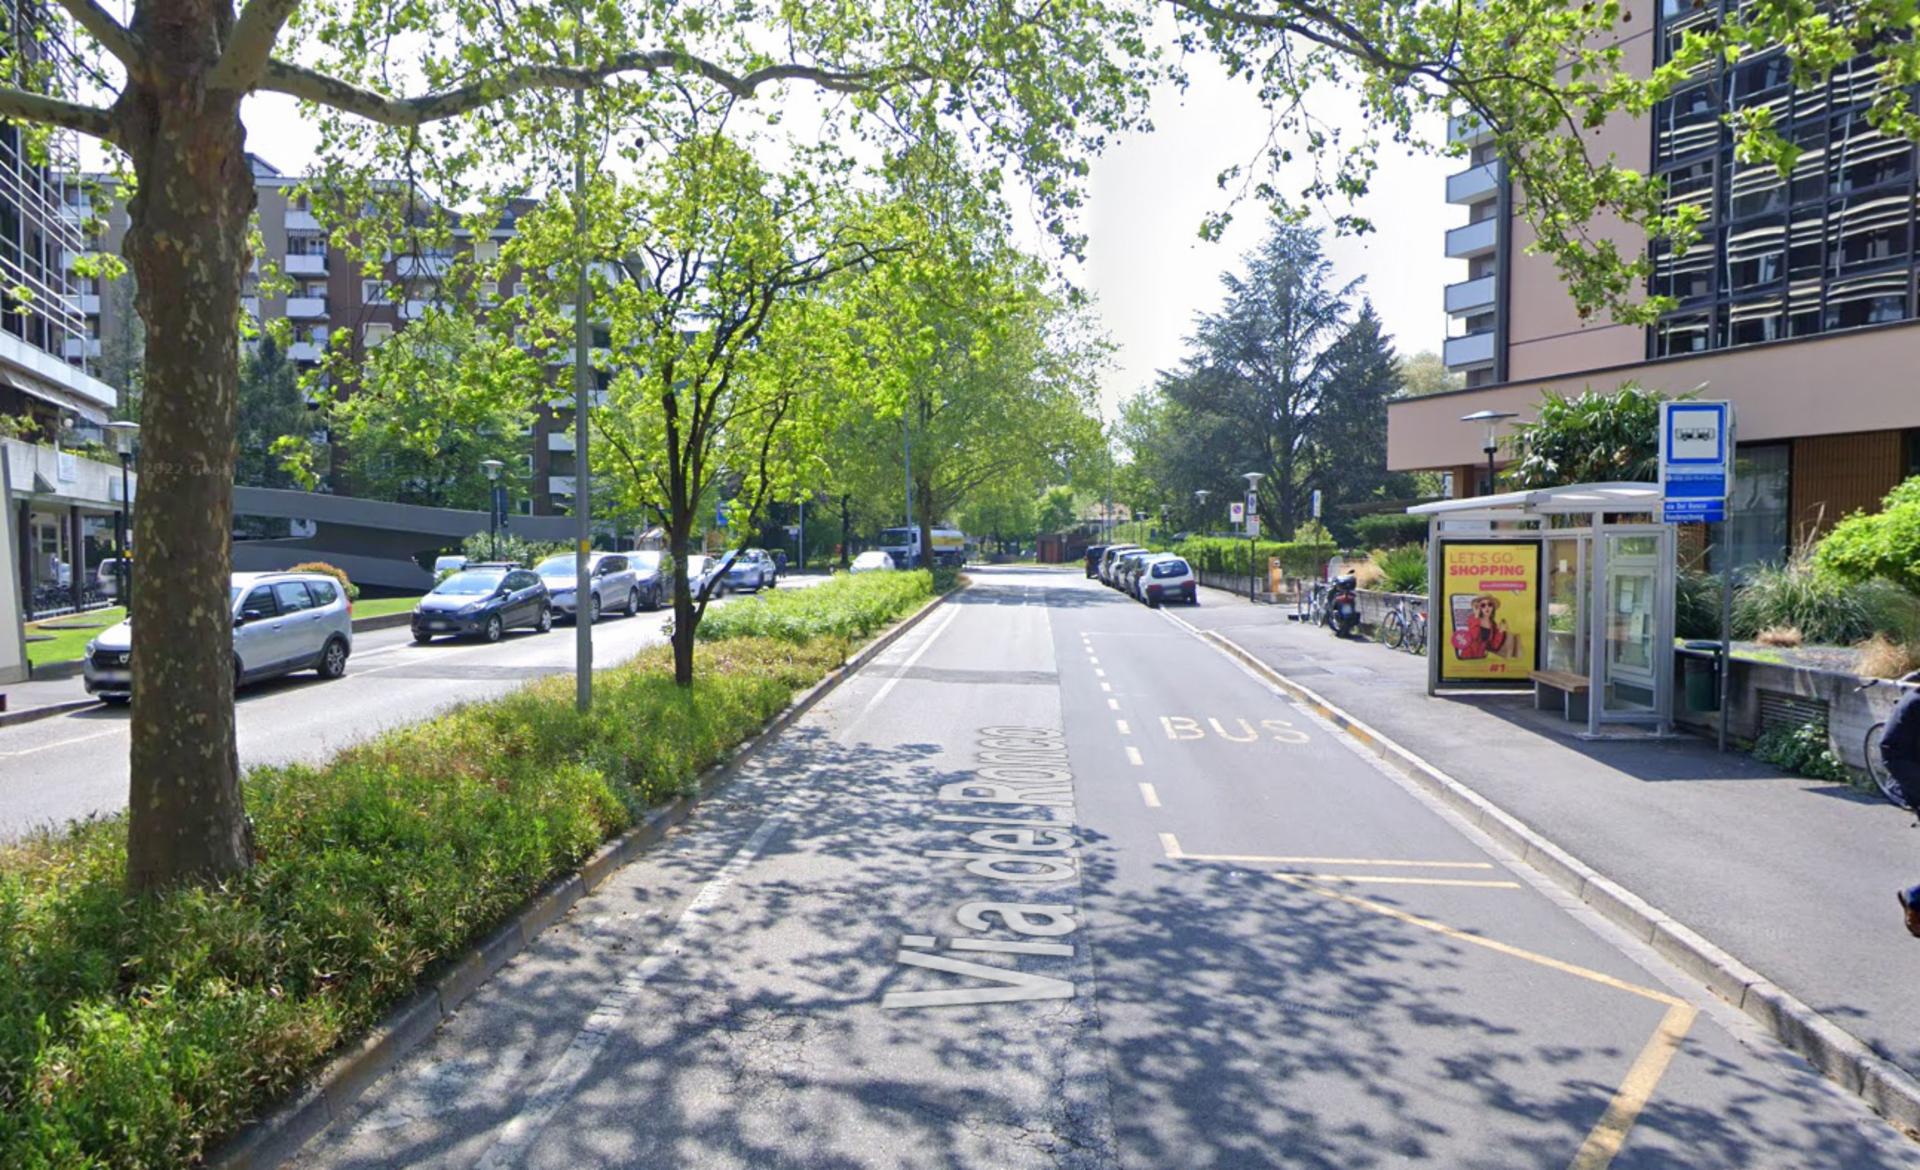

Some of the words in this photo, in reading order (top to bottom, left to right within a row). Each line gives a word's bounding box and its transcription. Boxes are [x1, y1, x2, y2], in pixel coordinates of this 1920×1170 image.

[1449, 551, 1488, 564] LET'S
[1491, 551, 1514, 564] GO
[1449, 564, 1525, 576] SHOPPING
[1158, 716, 1311, 744] BUS
